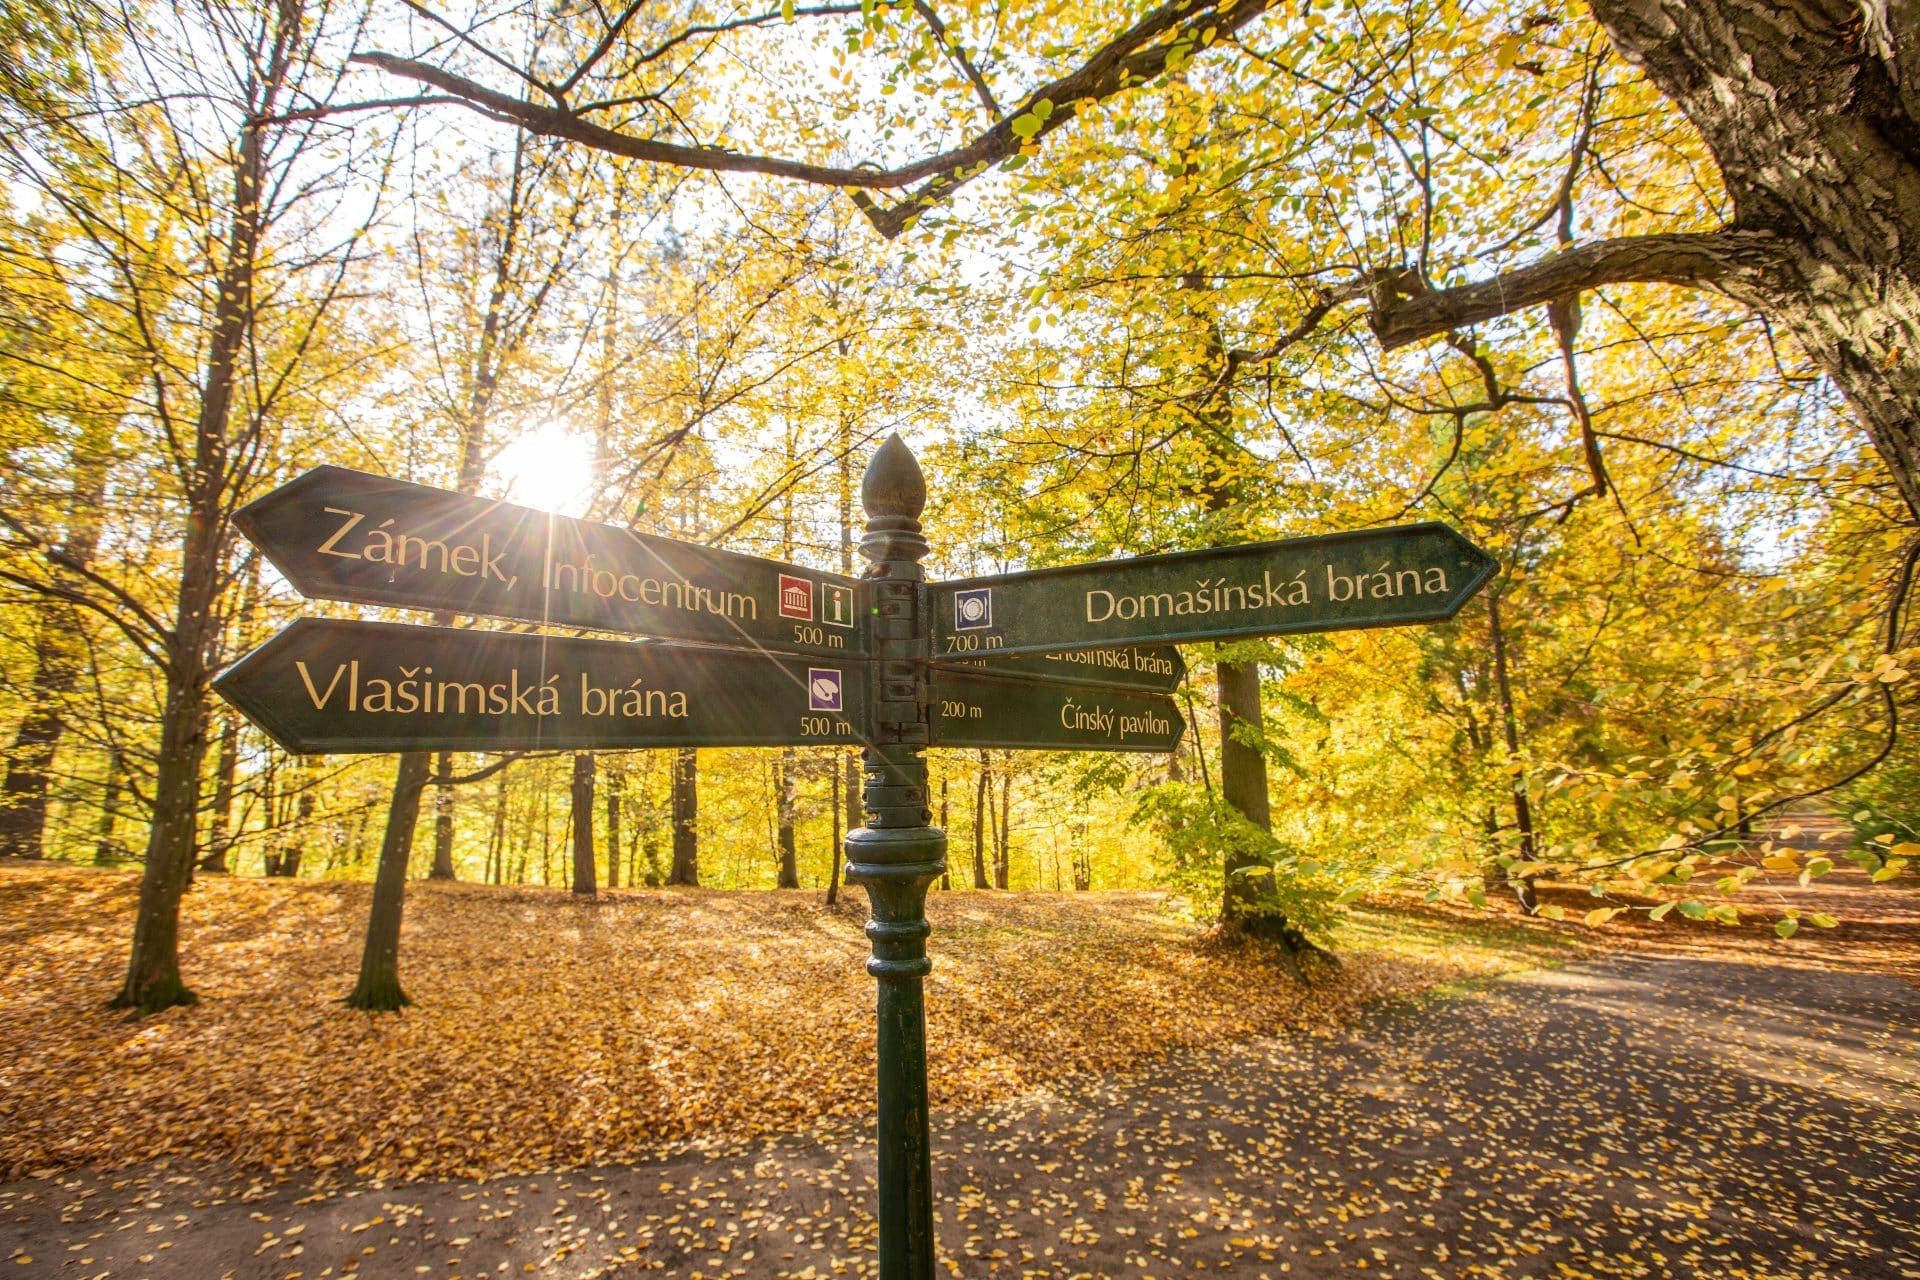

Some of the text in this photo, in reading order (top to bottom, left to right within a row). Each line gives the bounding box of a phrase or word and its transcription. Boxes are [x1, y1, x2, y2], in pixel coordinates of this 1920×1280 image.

[317, 506, 758, 620] Zámek, Infocentrum
[1086, 561, 1449, 622] Domašínská brána
[794, 625, 843, 648] 500 m
[946, 634, 1003, 654] 700 m
[1134, 647, 1173, 676] brána
[295, 660, 689, 718] Vlašimská brána
[941, 701, 982, 719] 200 m
[1061, 697, 1170, 740] Čínský pavilon
[800, 717, 851, 736] 500 m
